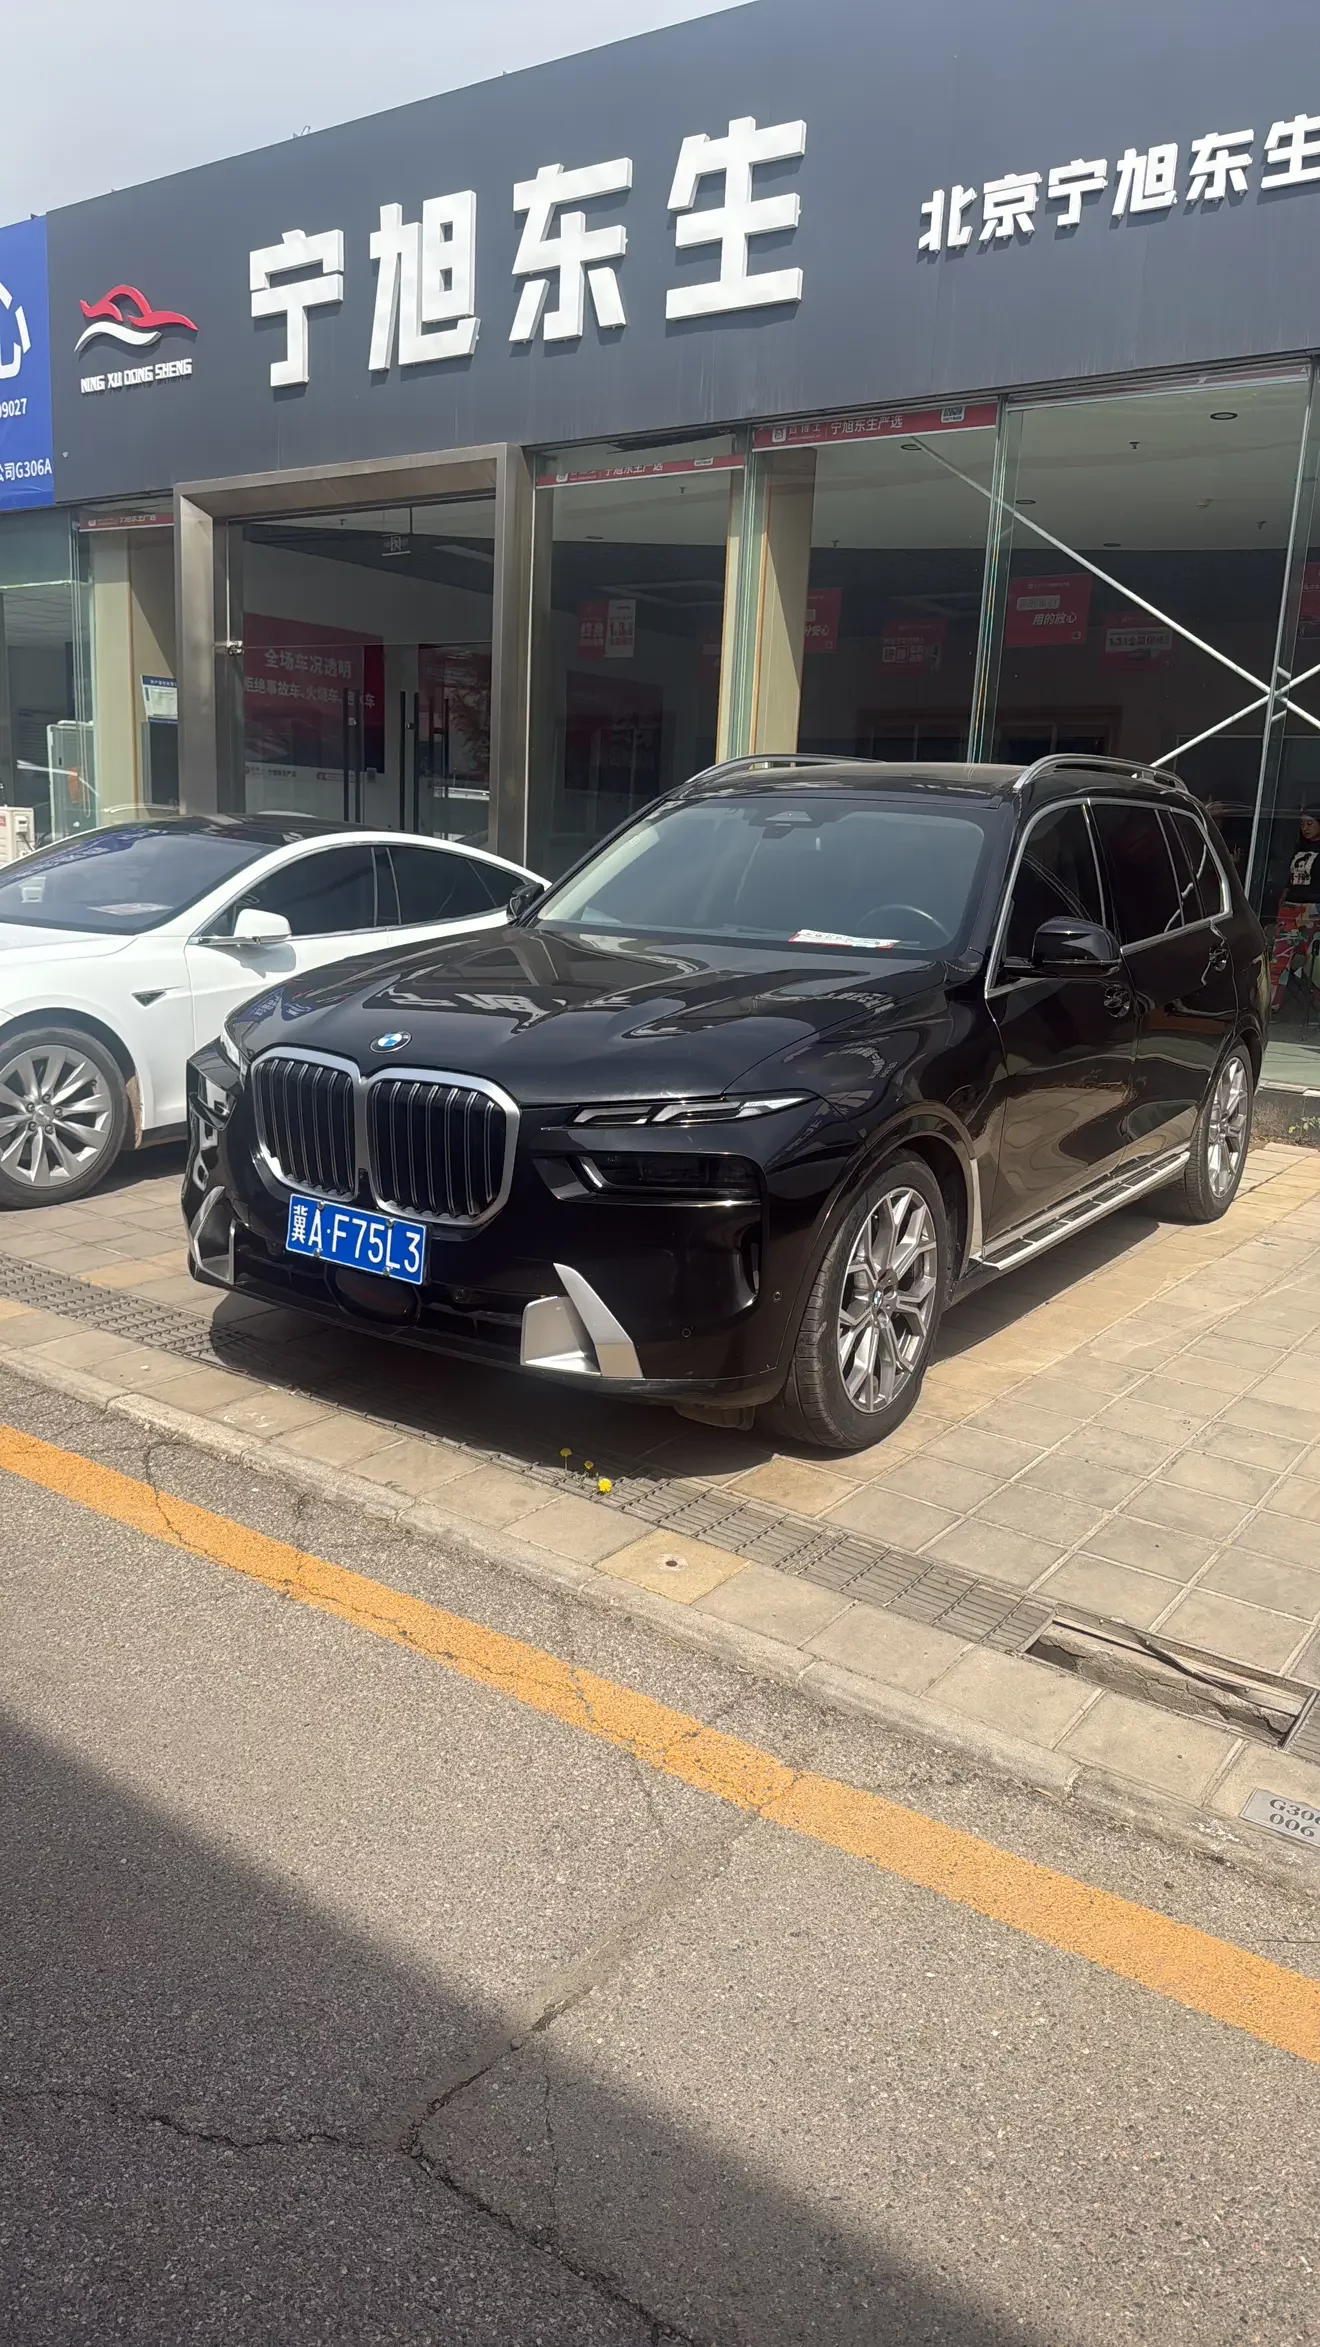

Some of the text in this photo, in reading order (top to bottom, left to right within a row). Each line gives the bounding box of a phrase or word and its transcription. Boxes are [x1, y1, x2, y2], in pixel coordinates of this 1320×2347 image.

[918, 113, 1320, 254] 北京宁旭东生
[249, 116, 807, 388] 宁旭东生
[80, 358, 192, 393] NING XU DONG SHENG
[0, 398, 27, 419] 9027
[264, 648, 352, 679] 全场车况透明
[1269, 1813, 1315, 1837] 006
